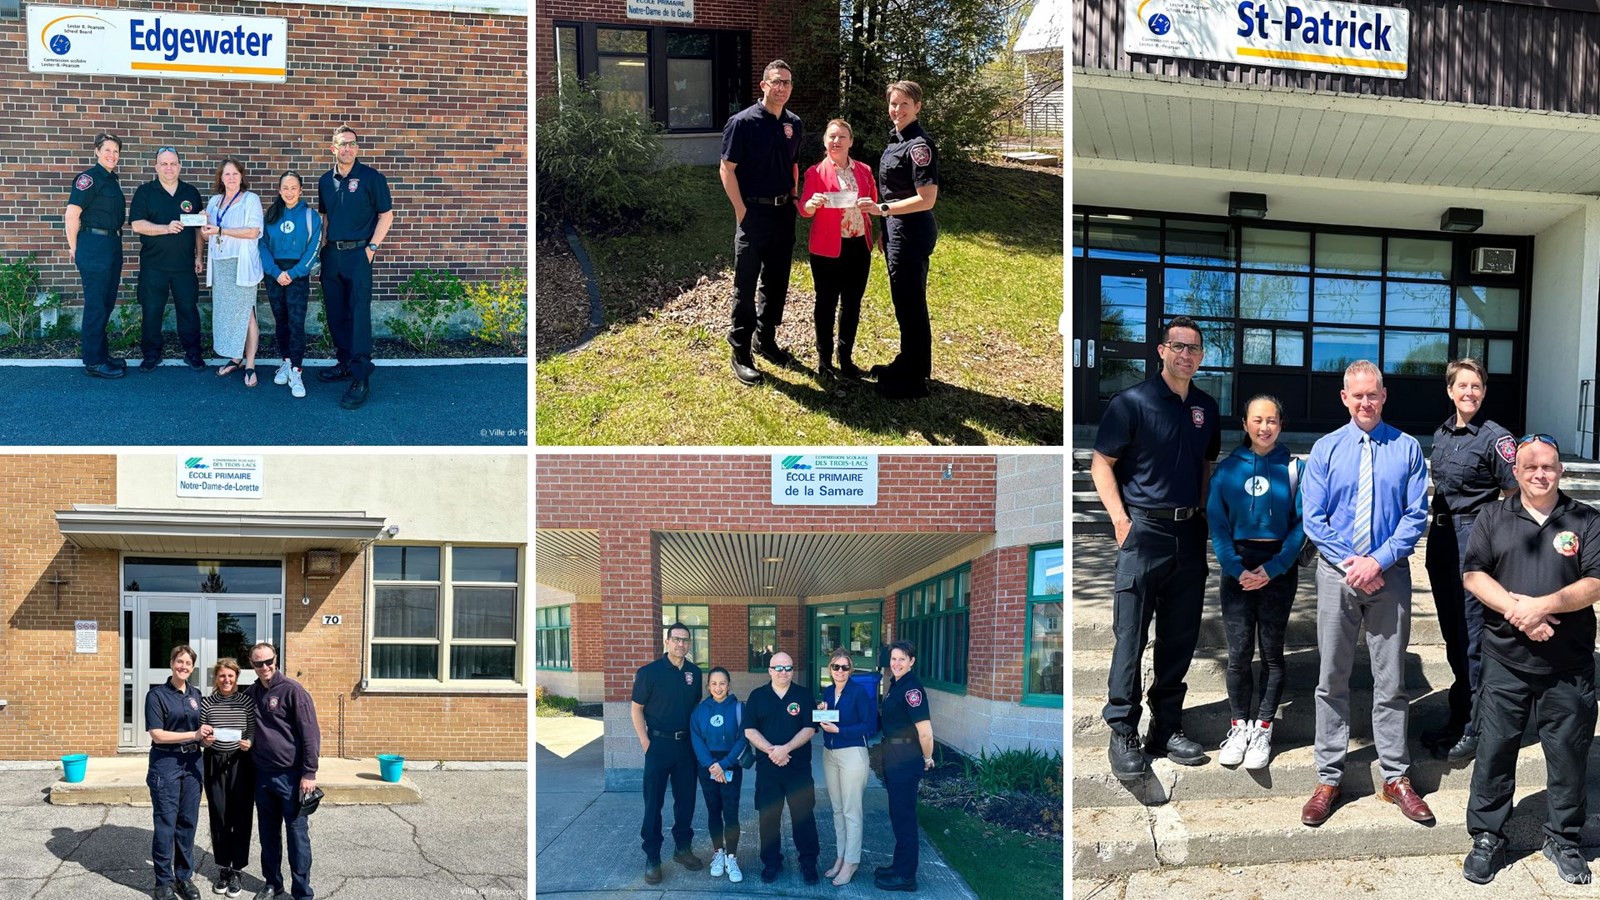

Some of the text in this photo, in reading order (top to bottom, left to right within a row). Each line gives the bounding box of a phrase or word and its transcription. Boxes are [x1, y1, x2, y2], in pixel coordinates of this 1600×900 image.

[628, 5, 692, 18] Notre-Dame de la Garde
[1237, 0, 1392, 51] St-Patrick
[130, 18, 273, 61] Edgewater
[786, 472, 815, 481] ÉCOLE
[180, 480, 259, 492] Notre-Dame-de-Lorette
[785, 485, 864, 496] de la Samare
[325, 616, 339, 624] 70
